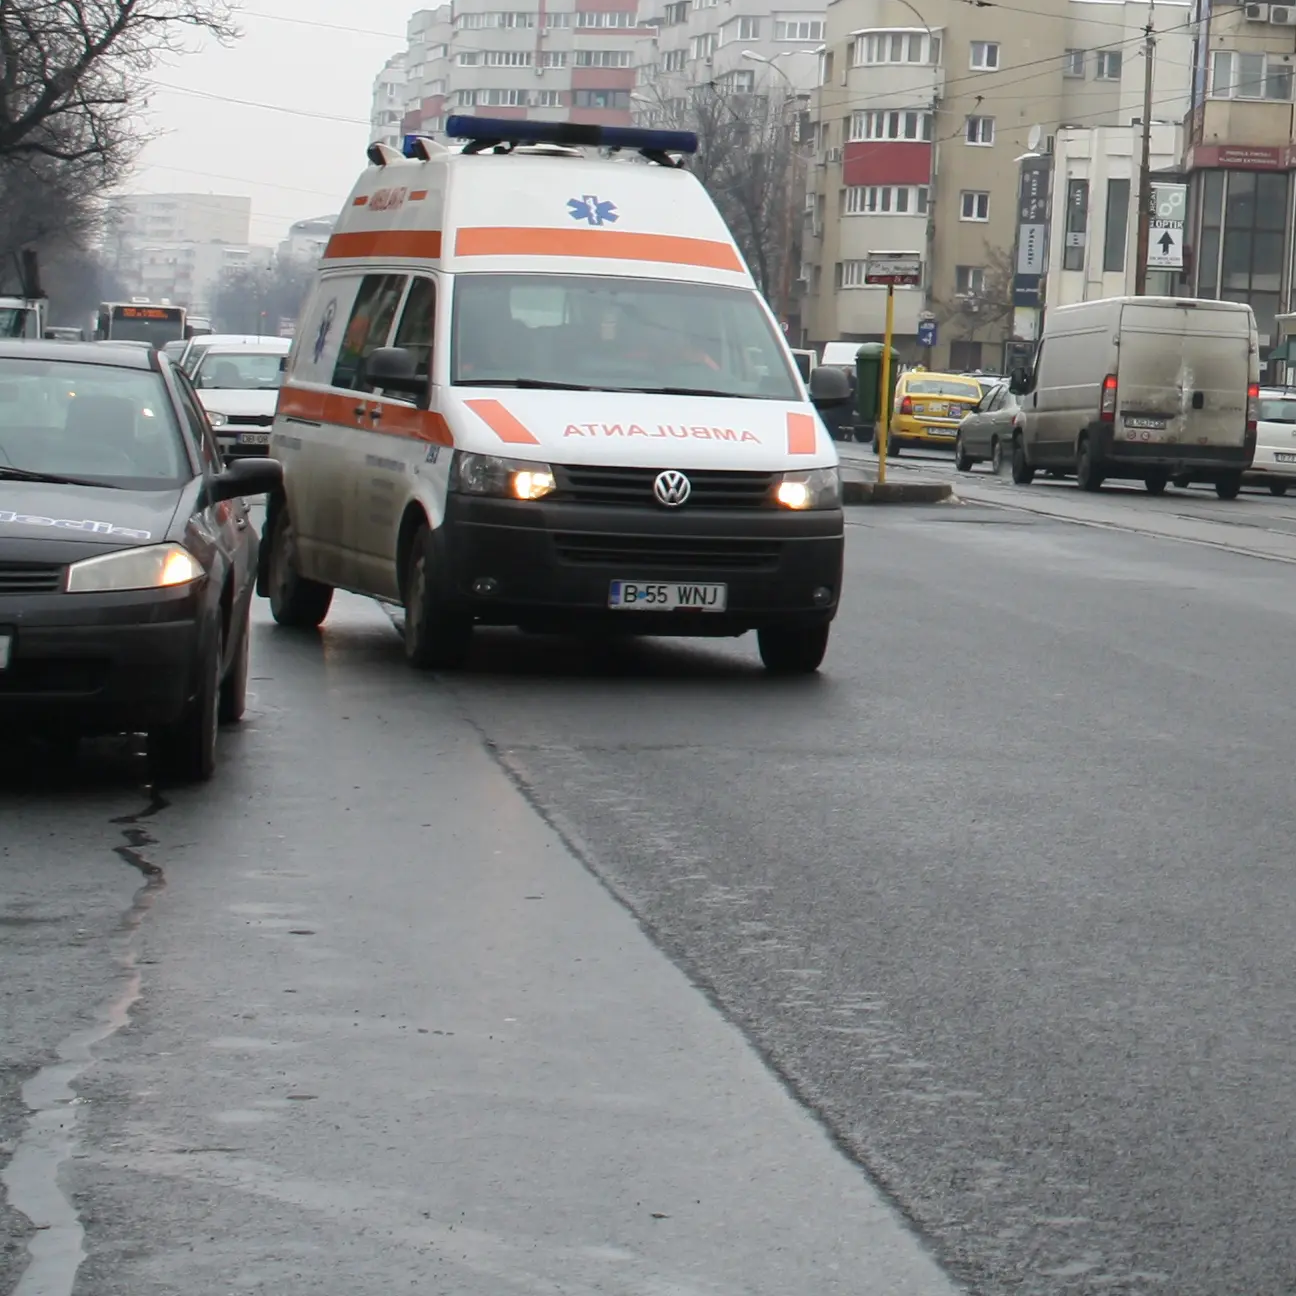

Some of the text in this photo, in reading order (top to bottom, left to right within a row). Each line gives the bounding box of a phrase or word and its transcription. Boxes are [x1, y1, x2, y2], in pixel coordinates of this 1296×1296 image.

[624, 584, 718, 605] B 55 WNJ
